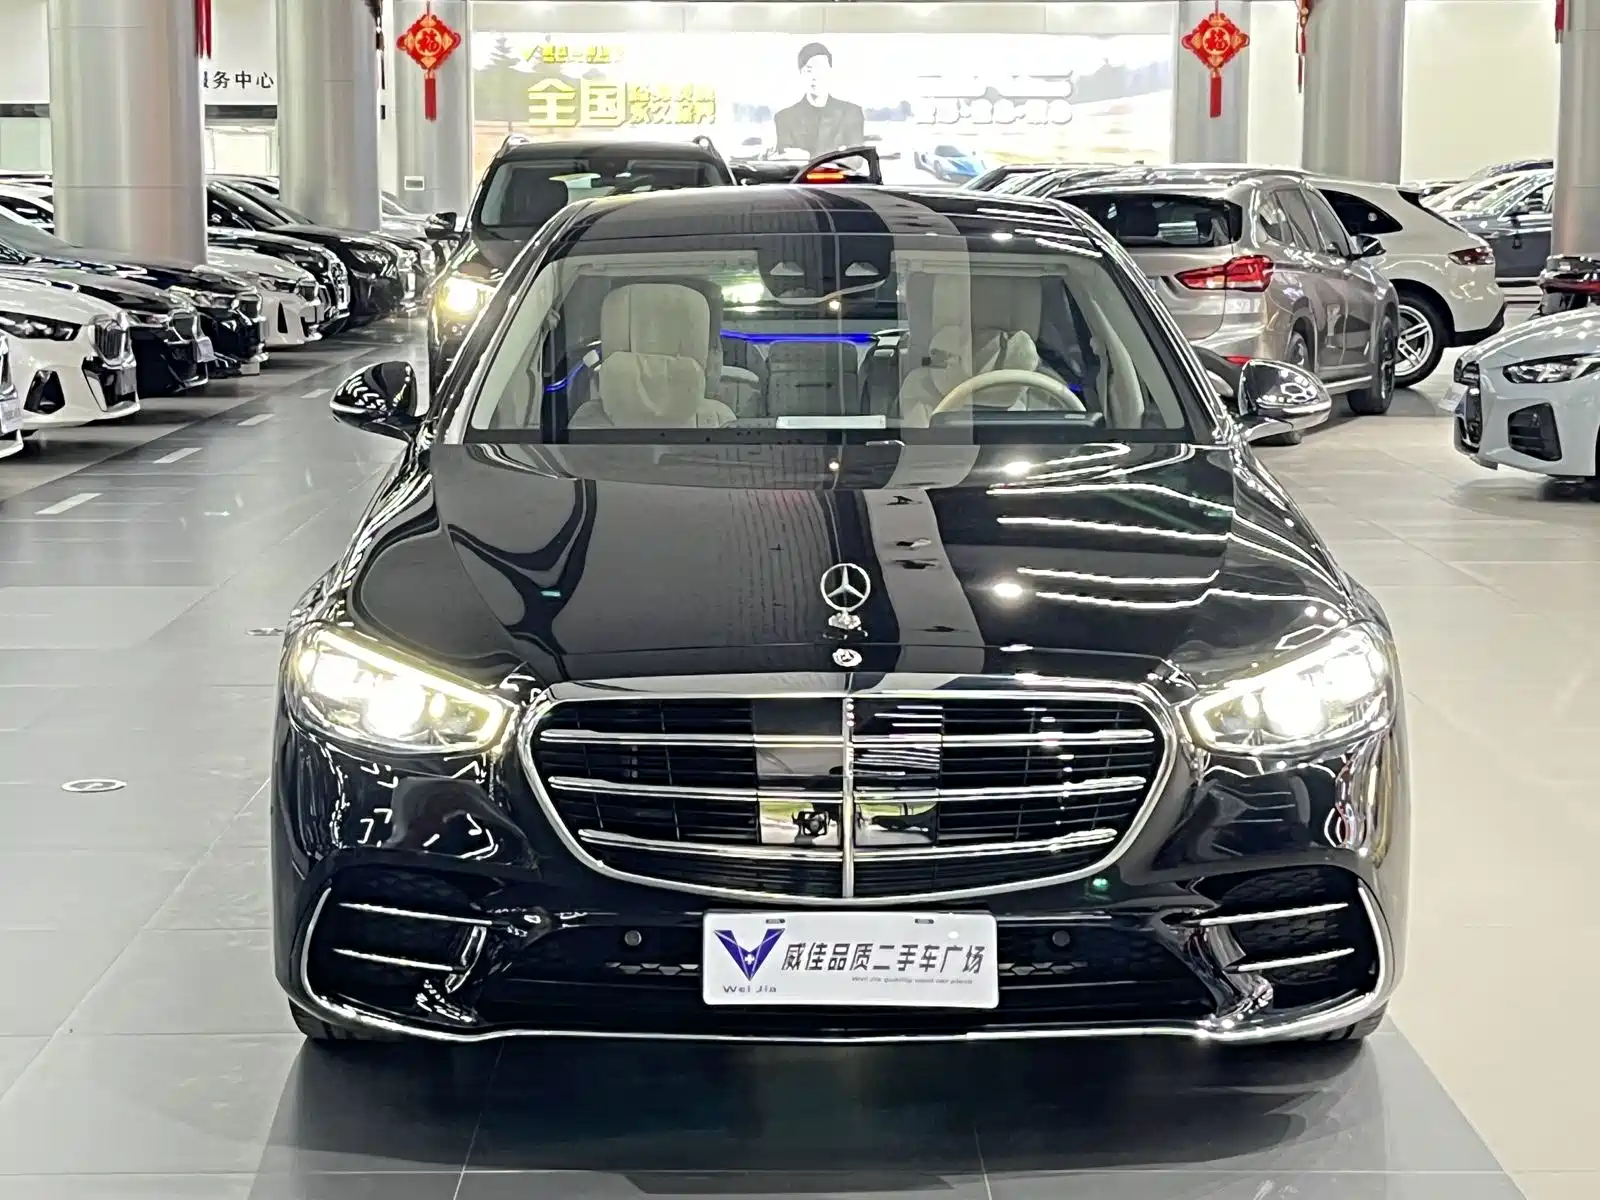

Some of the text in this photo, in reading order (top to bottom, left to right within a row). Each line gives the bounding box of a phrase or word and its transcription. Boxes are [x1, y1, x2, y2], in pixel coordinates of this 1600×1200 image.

[527, 78, 627, 127] 全国
[781, 942, 985, 973] 威佳品质二手车广场
[723, 984, 777, 993] Wei Jia
